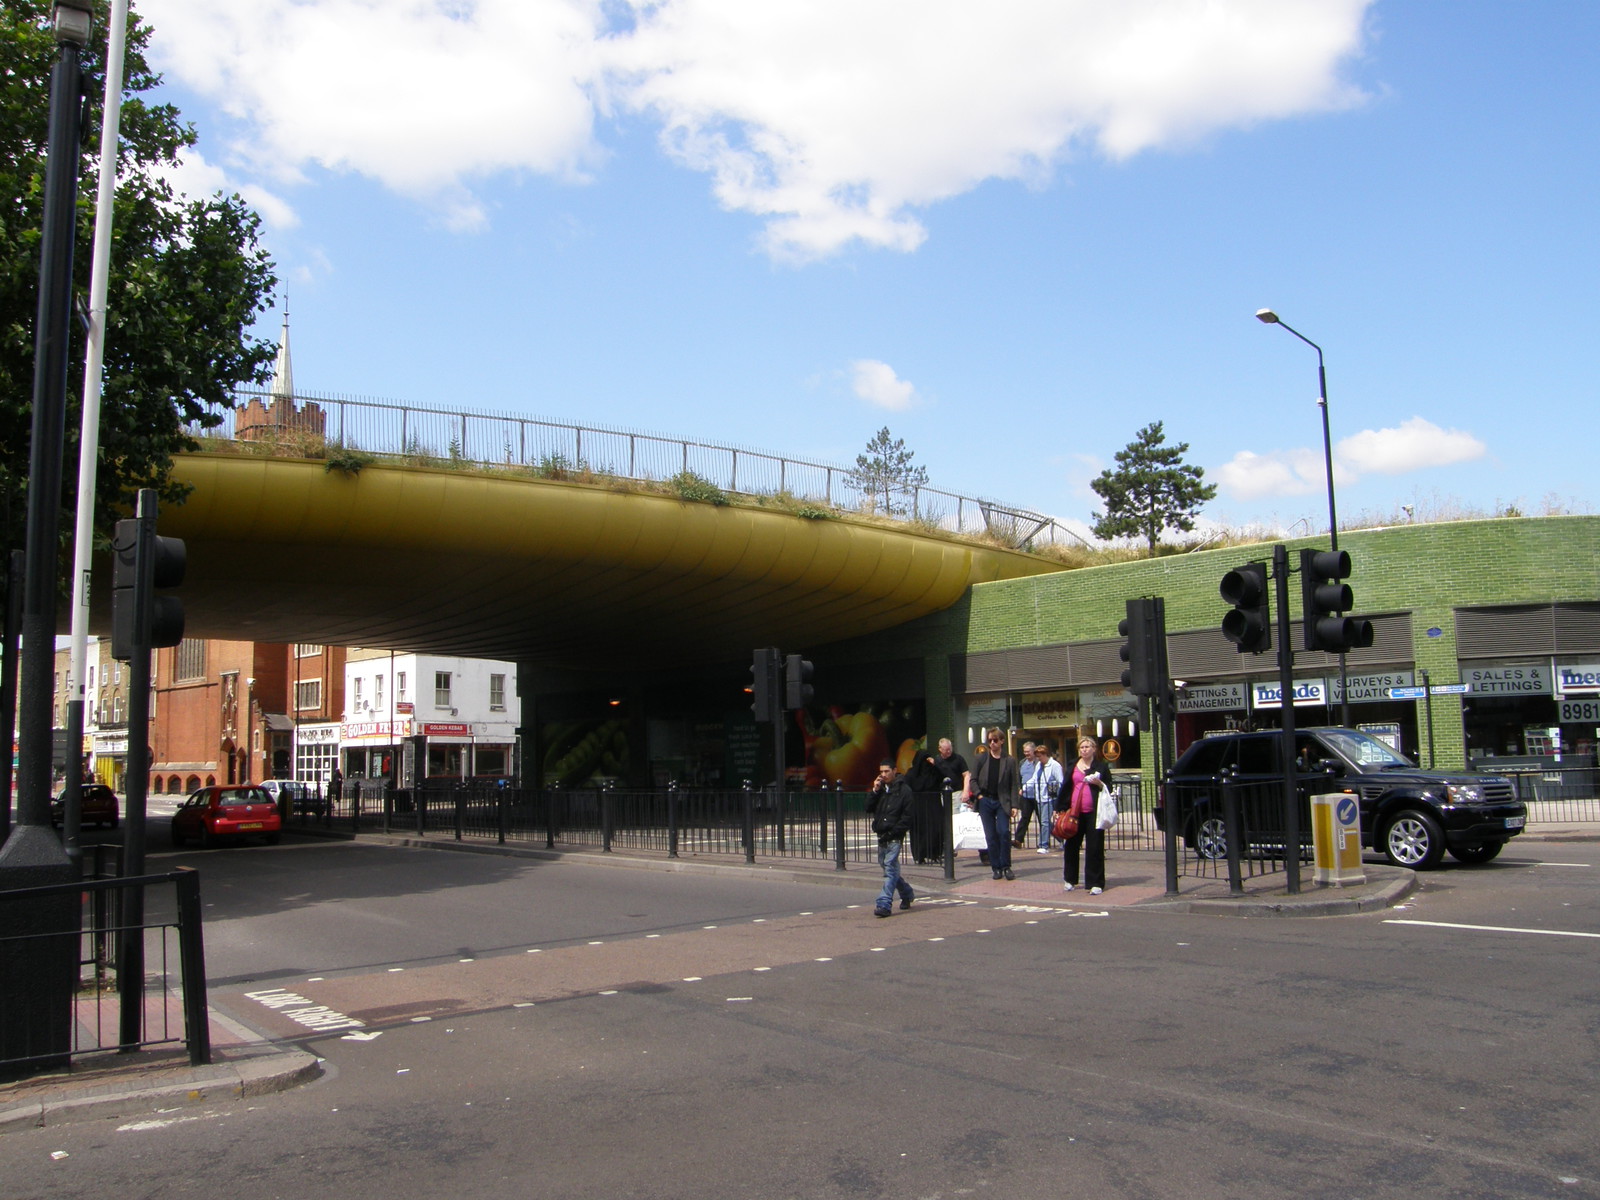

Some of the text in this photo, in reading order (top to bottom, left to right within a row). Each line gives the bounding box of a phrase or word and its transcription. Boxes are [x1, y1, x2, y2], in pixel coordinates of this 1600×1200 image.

[1472, 669, 1539, 680] SALES &
[1336, 676, 1404, 688] SURVEYS &
[1472, 681, 1542, 692] LETTINGS
[1185, 688, 1238, 699] LETTINGS &
[1257, 683, 1320, 701] mede
[1333, 687, 1389, 699] VLUATIO
[1180, 697, 1242, 710] MANAGEMENT
[1562, 703, 1599, 719] 8981
[348, 723, 376, 738] GOLDEN
